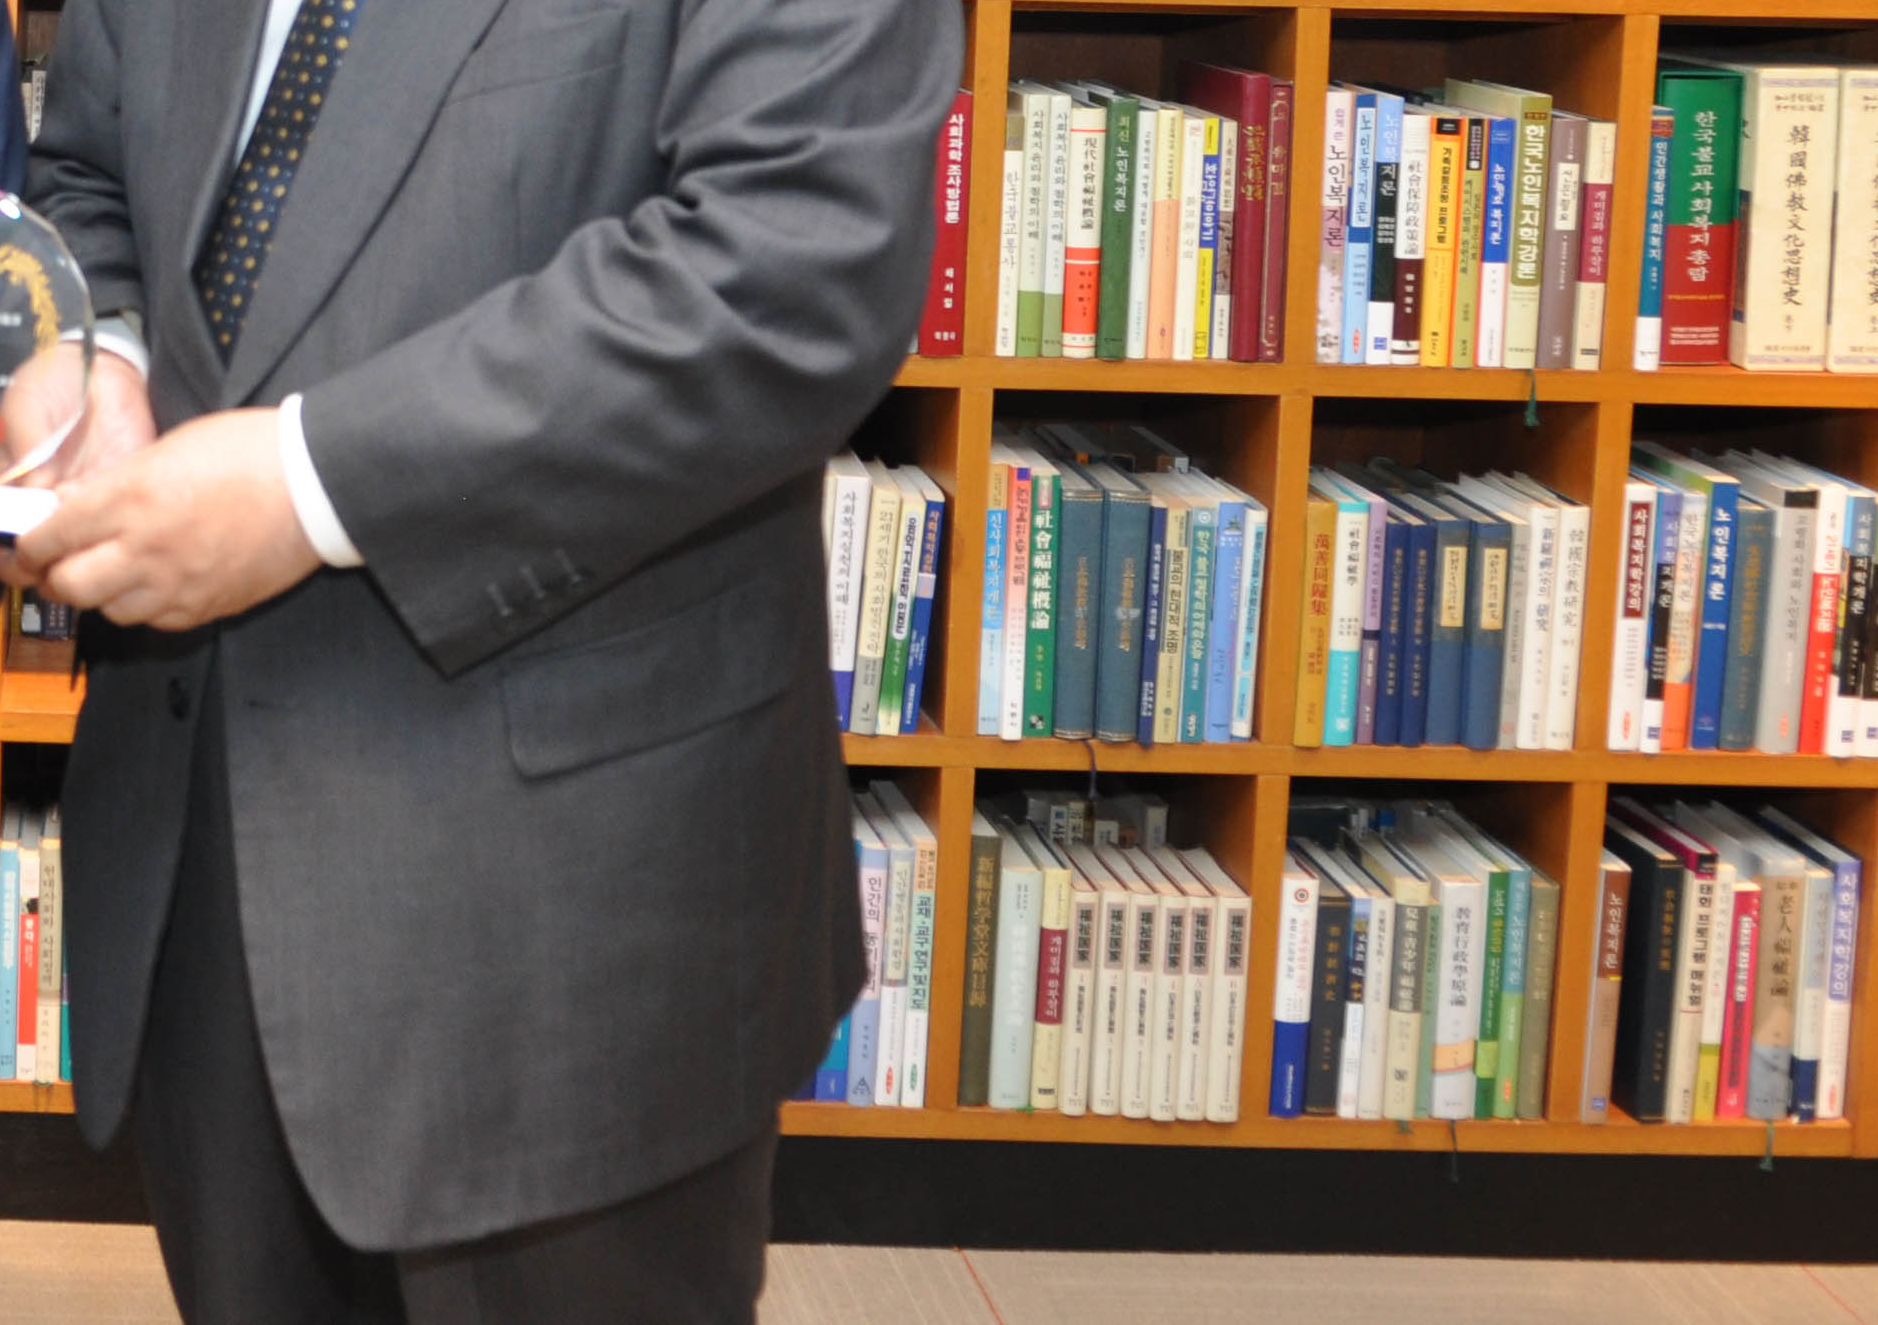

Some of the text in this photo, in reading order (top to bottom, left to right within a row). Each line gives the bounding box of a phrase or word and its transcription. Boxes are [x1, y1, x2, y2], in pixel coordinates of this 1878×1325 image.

[1324, 145, 1347, 248] 노인복지론
[1686, 110, 1718, 283] 한국불교사회복지총람
[1708, 508, 1732, 601] 노인복지론
